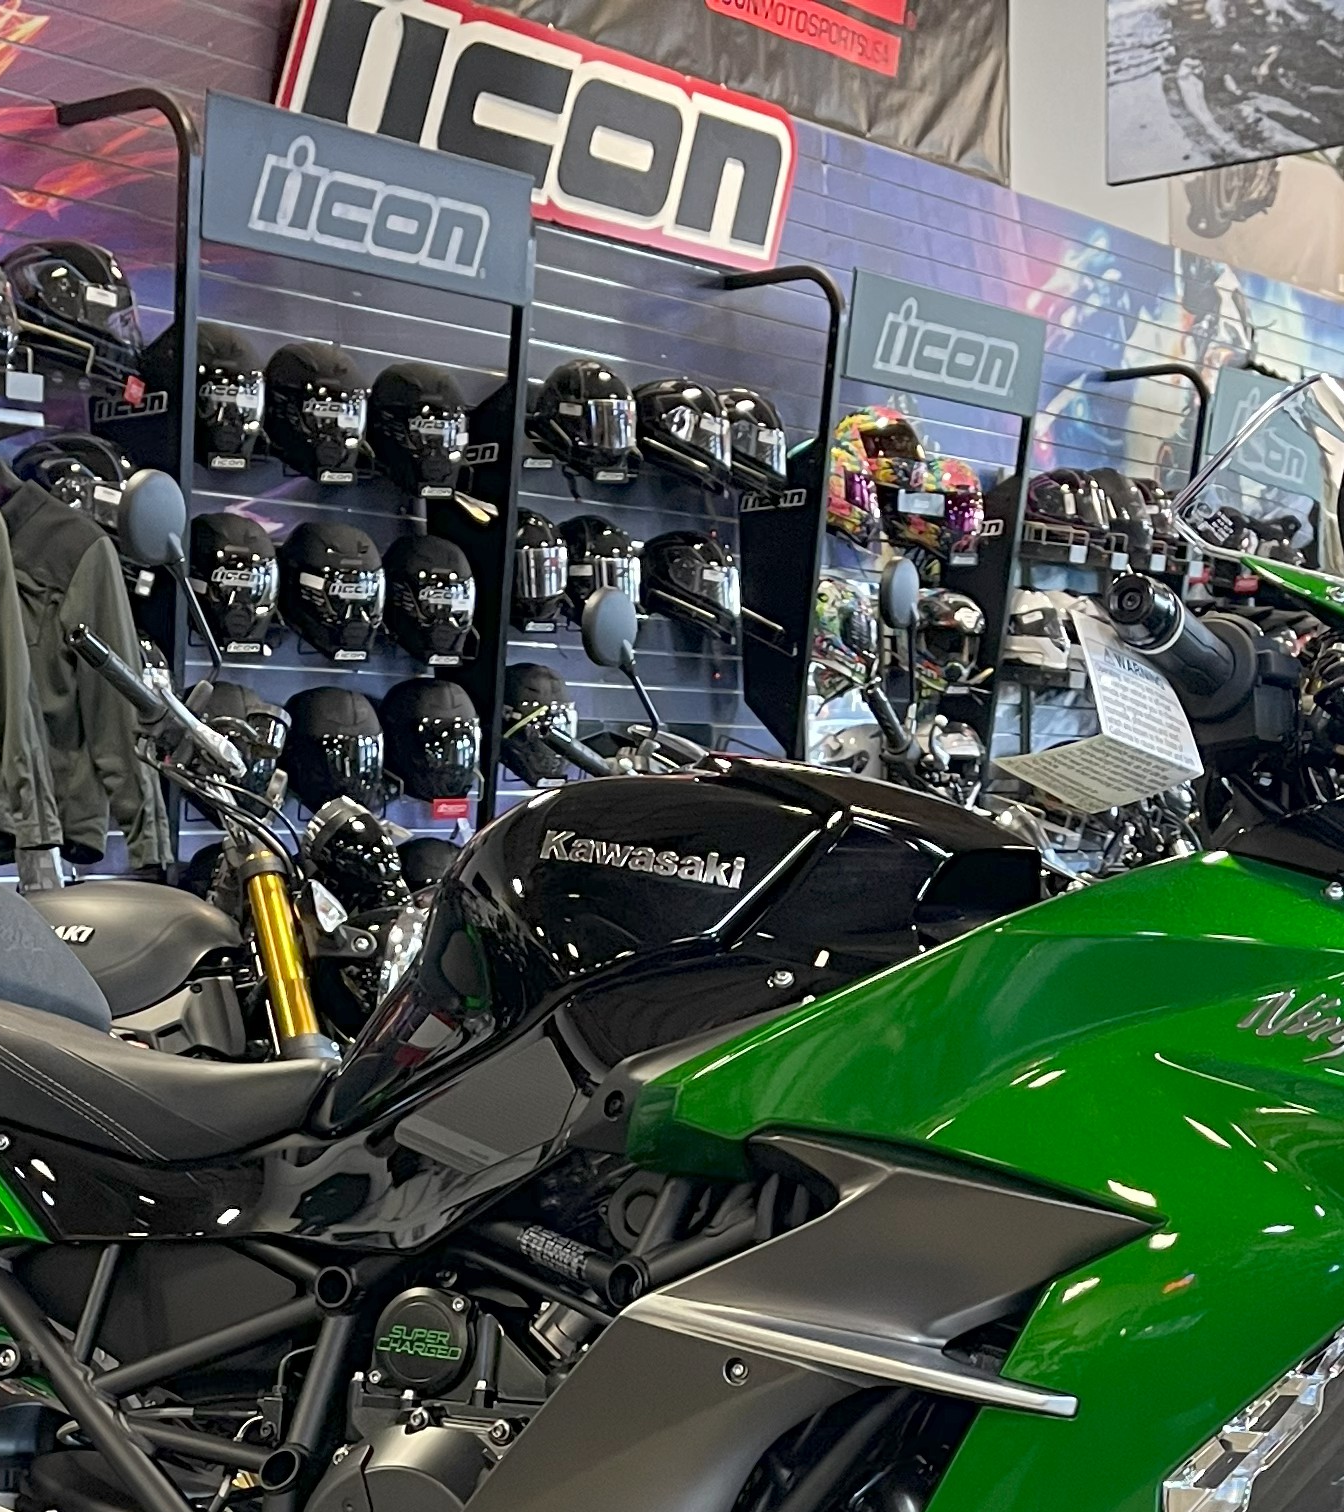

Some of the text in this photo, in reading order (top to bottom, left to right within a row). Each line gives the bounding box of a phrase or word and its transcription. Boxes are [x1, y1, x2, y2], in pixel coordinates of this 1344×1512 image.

[1113, 652, 1166, 691] WARNING
[539, 829, 746, 889] Kawasaki
[376, 1336, 462, 1361] CHARGED
[389, 1325, 450, 1344] SUPER
